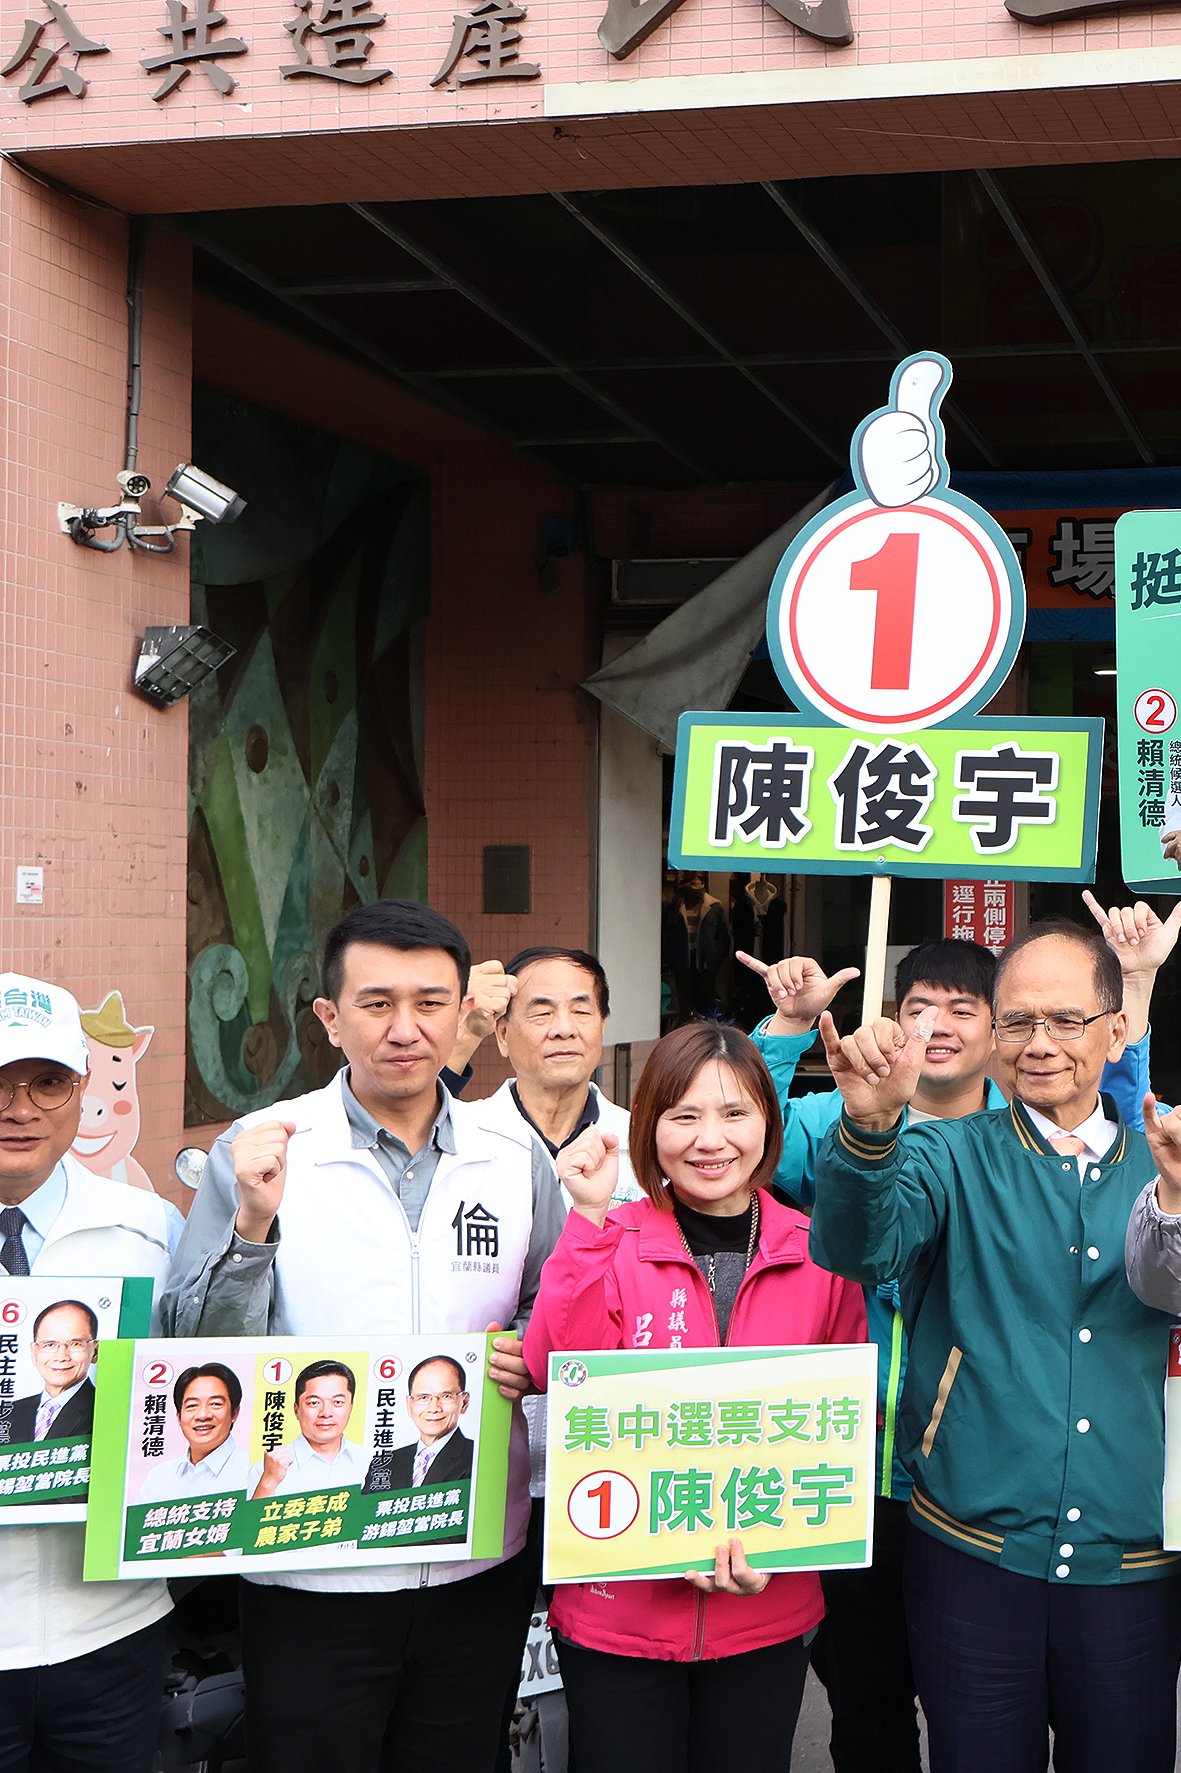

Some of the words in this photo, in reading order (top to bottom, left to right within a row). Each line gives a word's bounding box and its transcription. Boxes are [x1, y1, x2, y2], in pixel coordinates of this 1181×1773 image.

[0, 0, 541, 104] 公共造產
[1014, 523, 1114, 598] 場
[849, 533, 920, 690] 1
[1145, 695, 1165, 726] 2
[714, 742, 1055, 848] 陳俊宇
[1136, 739, 1166, 827] 賴清德
[0, 988, 52, 1015] 台灣
[451, 1200, 500, 1257] 倫
[451, 1261, 500, 1274] 宜蘭縣議員
[2, 1302, 20, 1324] 6
[149, 1366, 167, 1385] 2
[271, 1362, 283, 1380] 1
[380, 1360, 396, 1379] 6
[142, 1394, 166, 1458] 賴清德
[261, 1391, 286, 1453] 陳俊宇
[564, 1398, 860, 1452] 集中選票支持
[370, 1388, 396, 1491] 民主進步黨
[144, 1497, 238, 1529] 總統支持
[260, 1491, 350, 1523] 立委牽成
[376, 1488, 462, 1518] 票投民進黨
[587, 1480, 612, 1529] 1
[649, 1463, 854, 1534] 陳俊宇
[136, 1521, 232, 1556] 宜蘭女婿
[254, 1516, 343, 1549] 農家子弟
[361, 1511, 464, 1542] 游錫堃當院長
